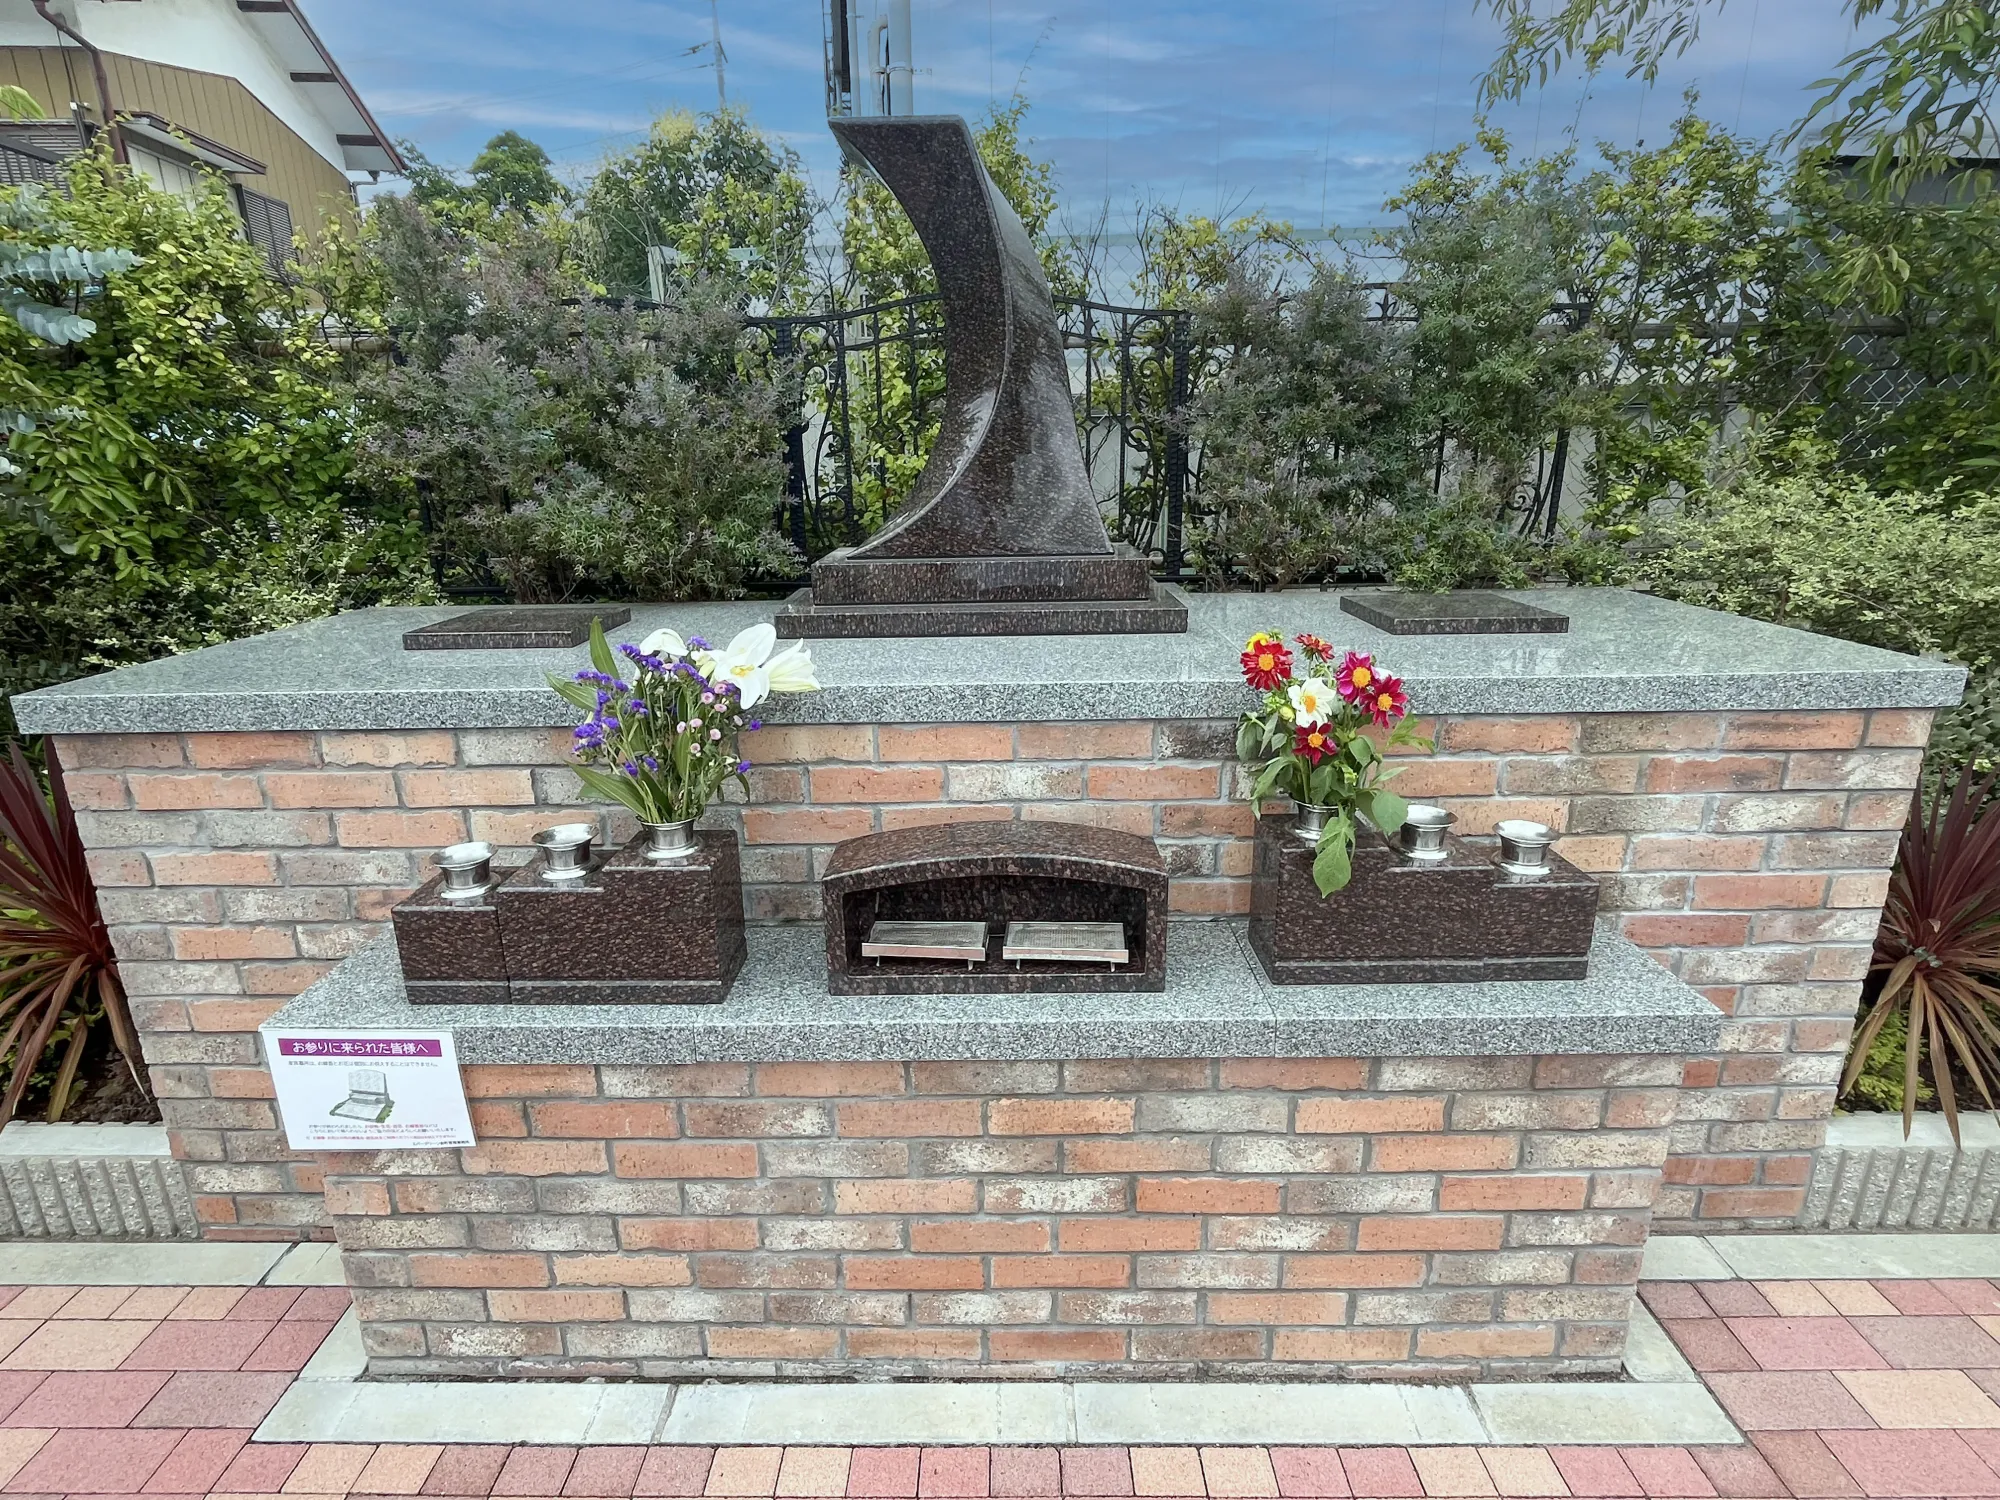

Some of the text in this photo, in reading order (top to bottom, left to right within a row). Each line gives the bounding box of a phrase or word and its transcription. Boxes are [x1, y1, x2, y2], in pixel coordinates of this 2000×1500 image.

[292, 1041, 428, 1054] お参りに来られた皆様へ
